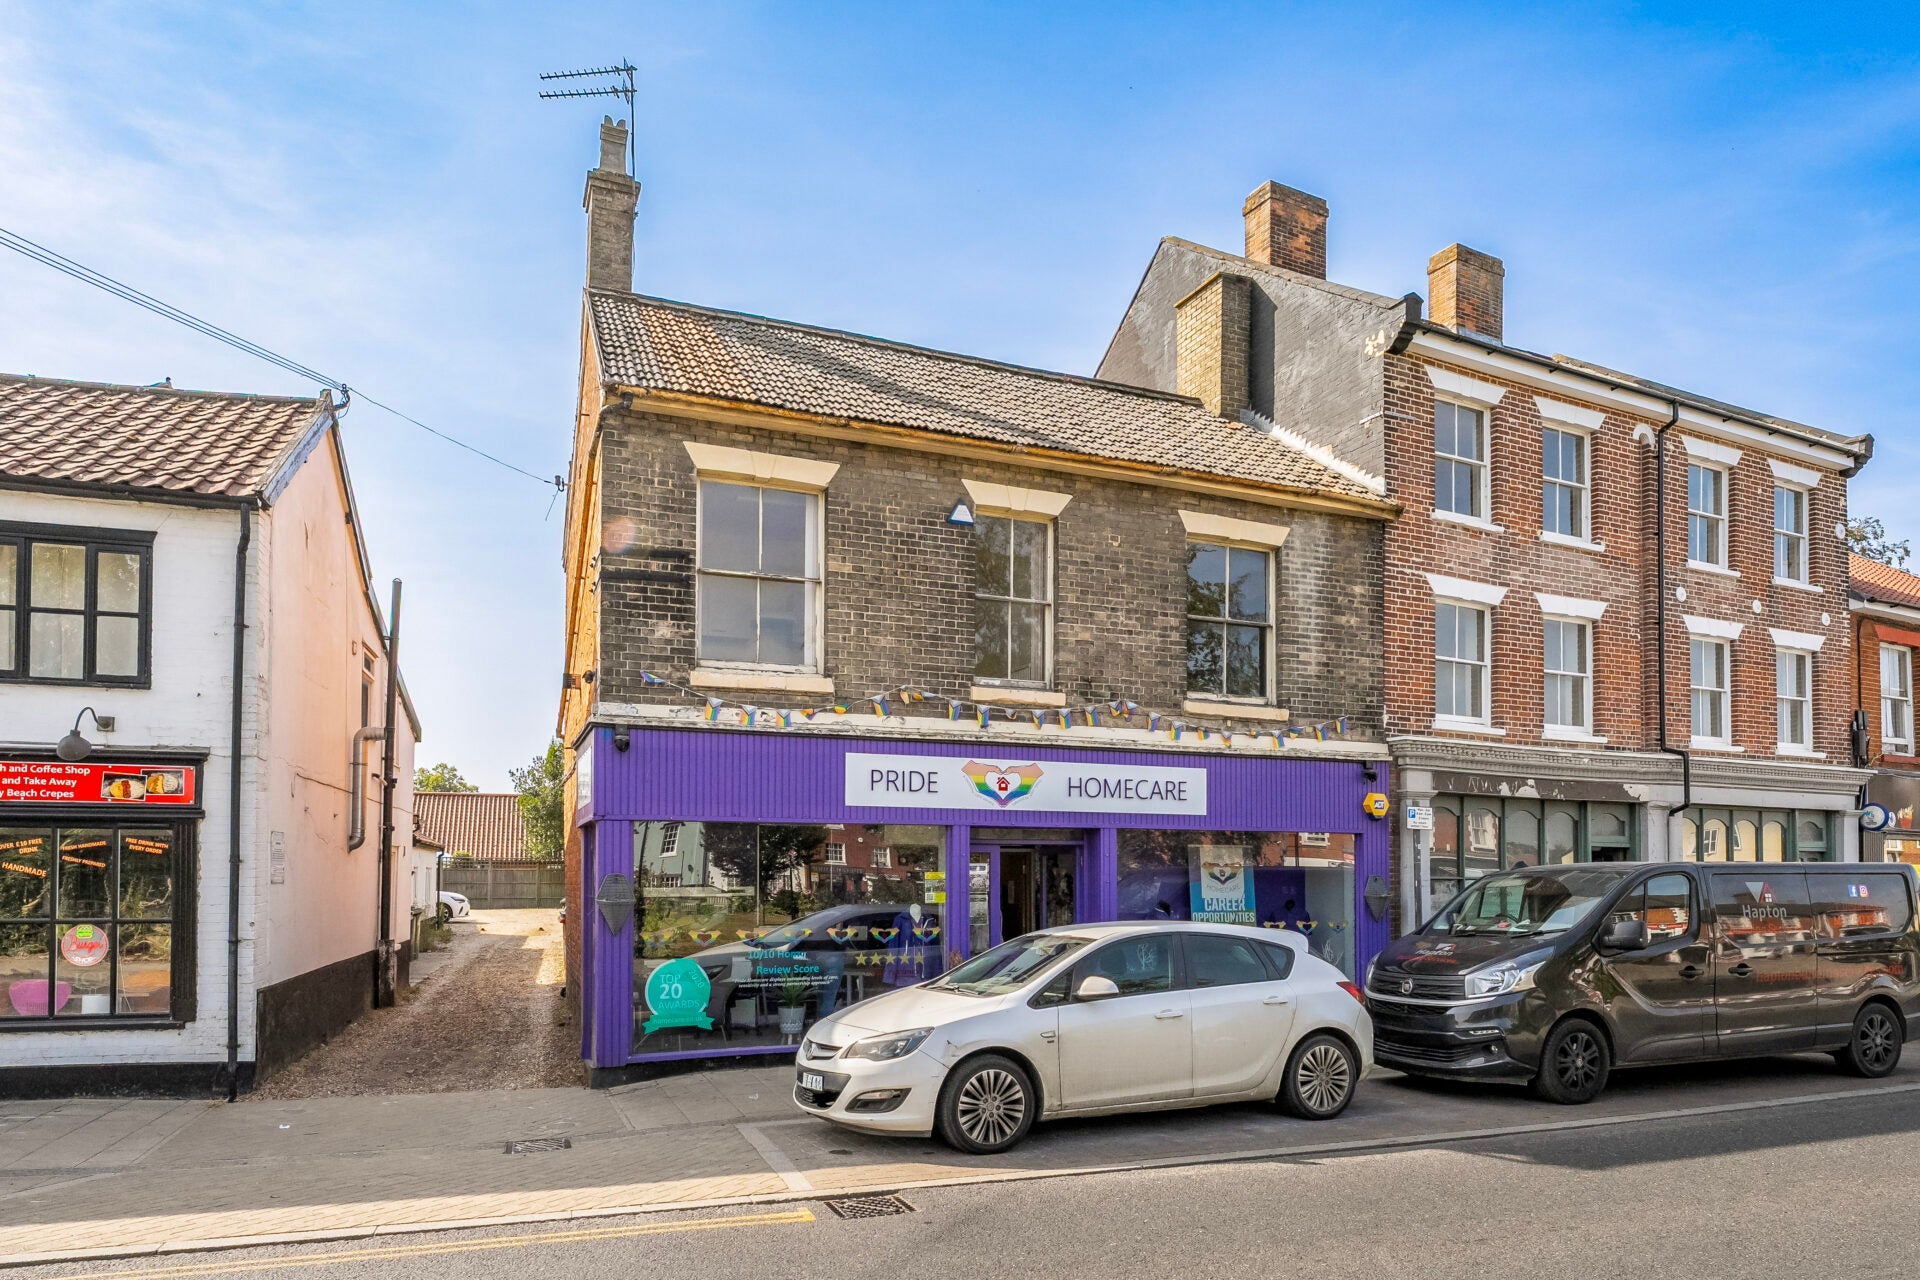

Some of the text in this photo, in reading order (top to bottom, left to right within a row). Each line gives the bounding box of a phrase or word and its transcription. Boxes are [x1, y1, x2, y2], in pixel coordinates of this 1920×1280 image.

[8, 764, 28, 773] and
[30, 765, 63, 774] Coffee
[65, 766, 91, 776] Shop
[2, 776, 77, 788] and Take Away
[870, 769, 939, 794] PRIDE
[1068, 776, 1188, 801] HOMECARE
[7, 788, 37, 797] Beach
[40, 790, 74, 800] Crepes
[2, 862, 47, 877] HANDMADE
[1204, 897, 1246, 911] CAREER
[1192, 912, 1255, 923] OPPORTUNITIES
[1742, 904, 1787, 922] Hapton
[756, 964, 819, 975] Review Score
[660, 974, 680, 984] TOP
[660, 984, 683, 999] 20
[658, 1000, 700, 1009] AWARDS
